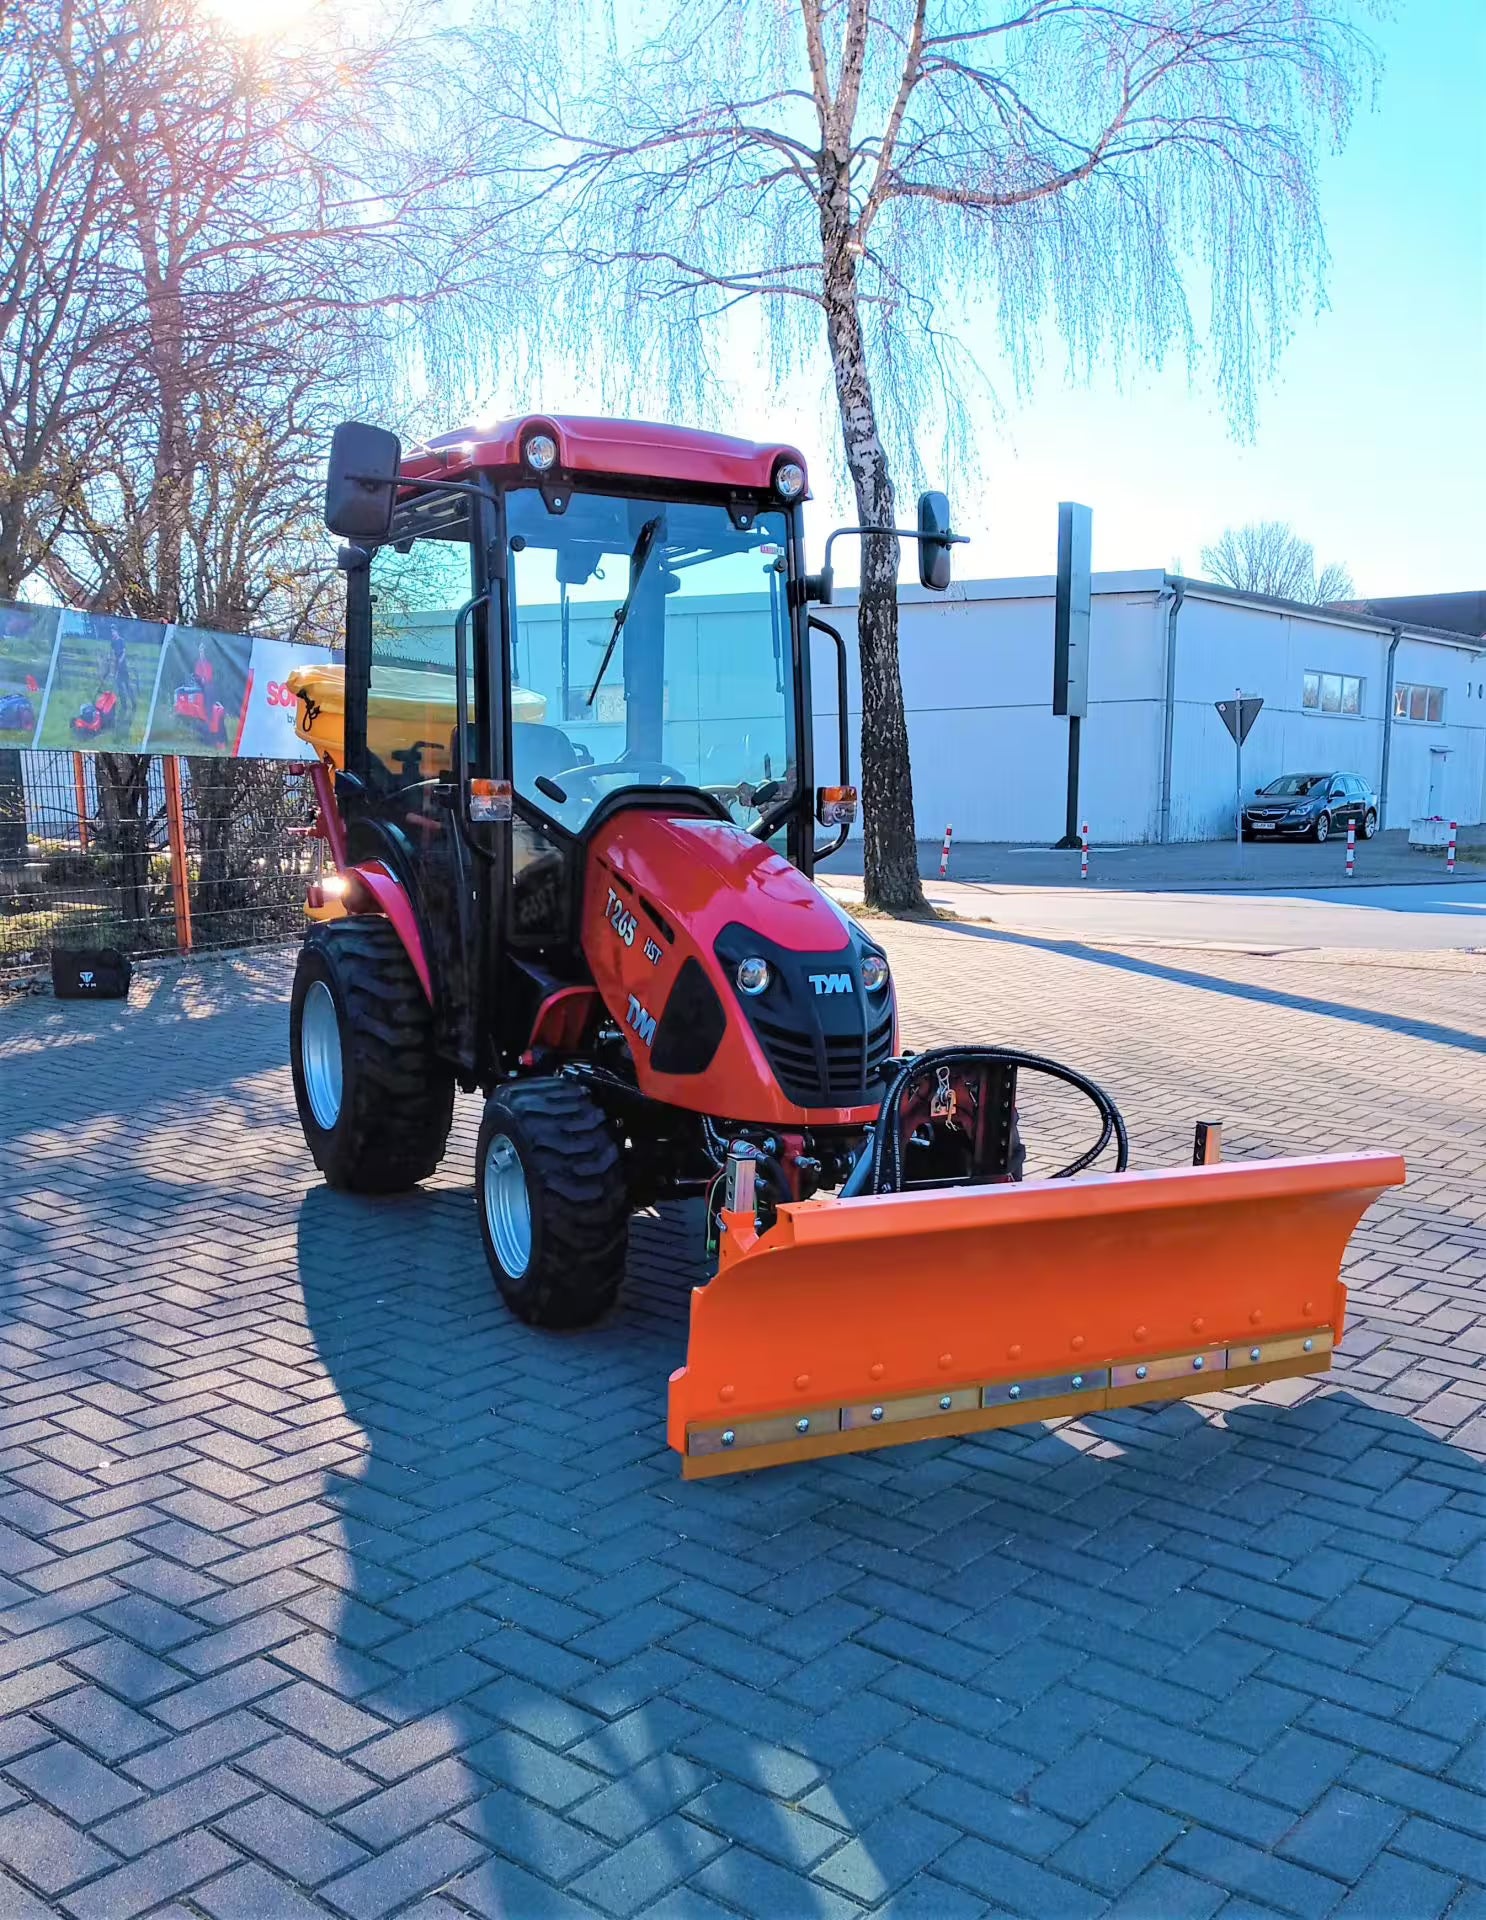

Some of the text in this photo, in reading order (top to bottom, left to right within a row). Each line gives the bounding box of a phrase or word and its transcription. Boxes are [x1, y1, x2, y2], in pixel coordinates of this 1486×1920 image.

[604, 888, 663, 966] T265 HST
[809, 973, 853, 994] TYM
[625, 993, 657, 1046] TYM
